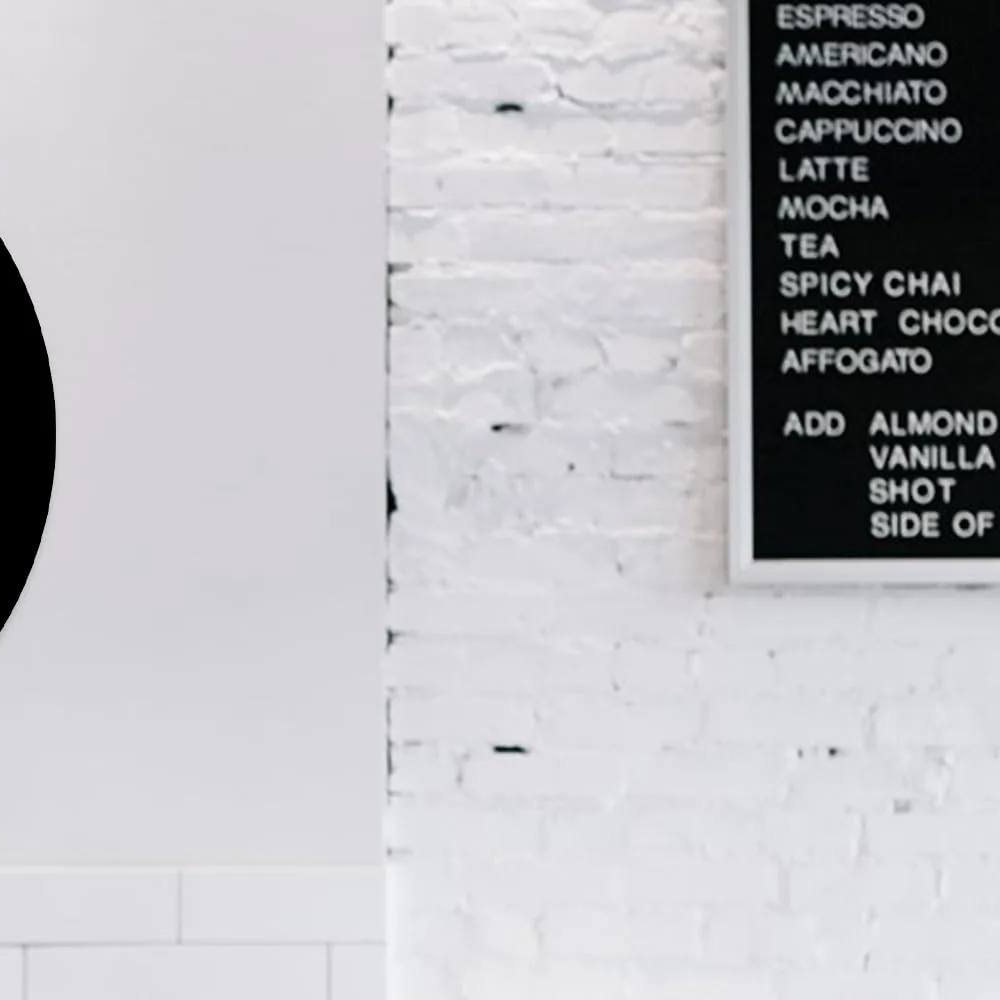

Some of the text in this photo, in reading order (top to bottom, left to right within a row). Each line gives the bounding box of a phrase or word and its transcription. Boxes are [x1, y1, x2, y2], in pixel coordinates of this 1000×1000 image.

[776, 3, 925, 30] ESPRESSO
[776, 41, 948, 67] AMERICANO
[776, 79, 948, 106] MACCHIATO
[774, 117, 963, 144] CAPPUCCINO
[779, 156, 869, 182] LATTE
[778, 194, 889, 221] MOCHA
[779, 232, 840, 259] TEA
[779, 270, 961, 298] SPICY CHAI
[780, 309, 878, 336] HEART
[781, 347, 933, 375] AFFOGATO
[783, 409, 998, 437] ADD ALMOND
[869, 444, 996, 471] VANILLA
[868, 477, 956, 505] SHOT
[870, 510, 995, 539] SIDE OF
